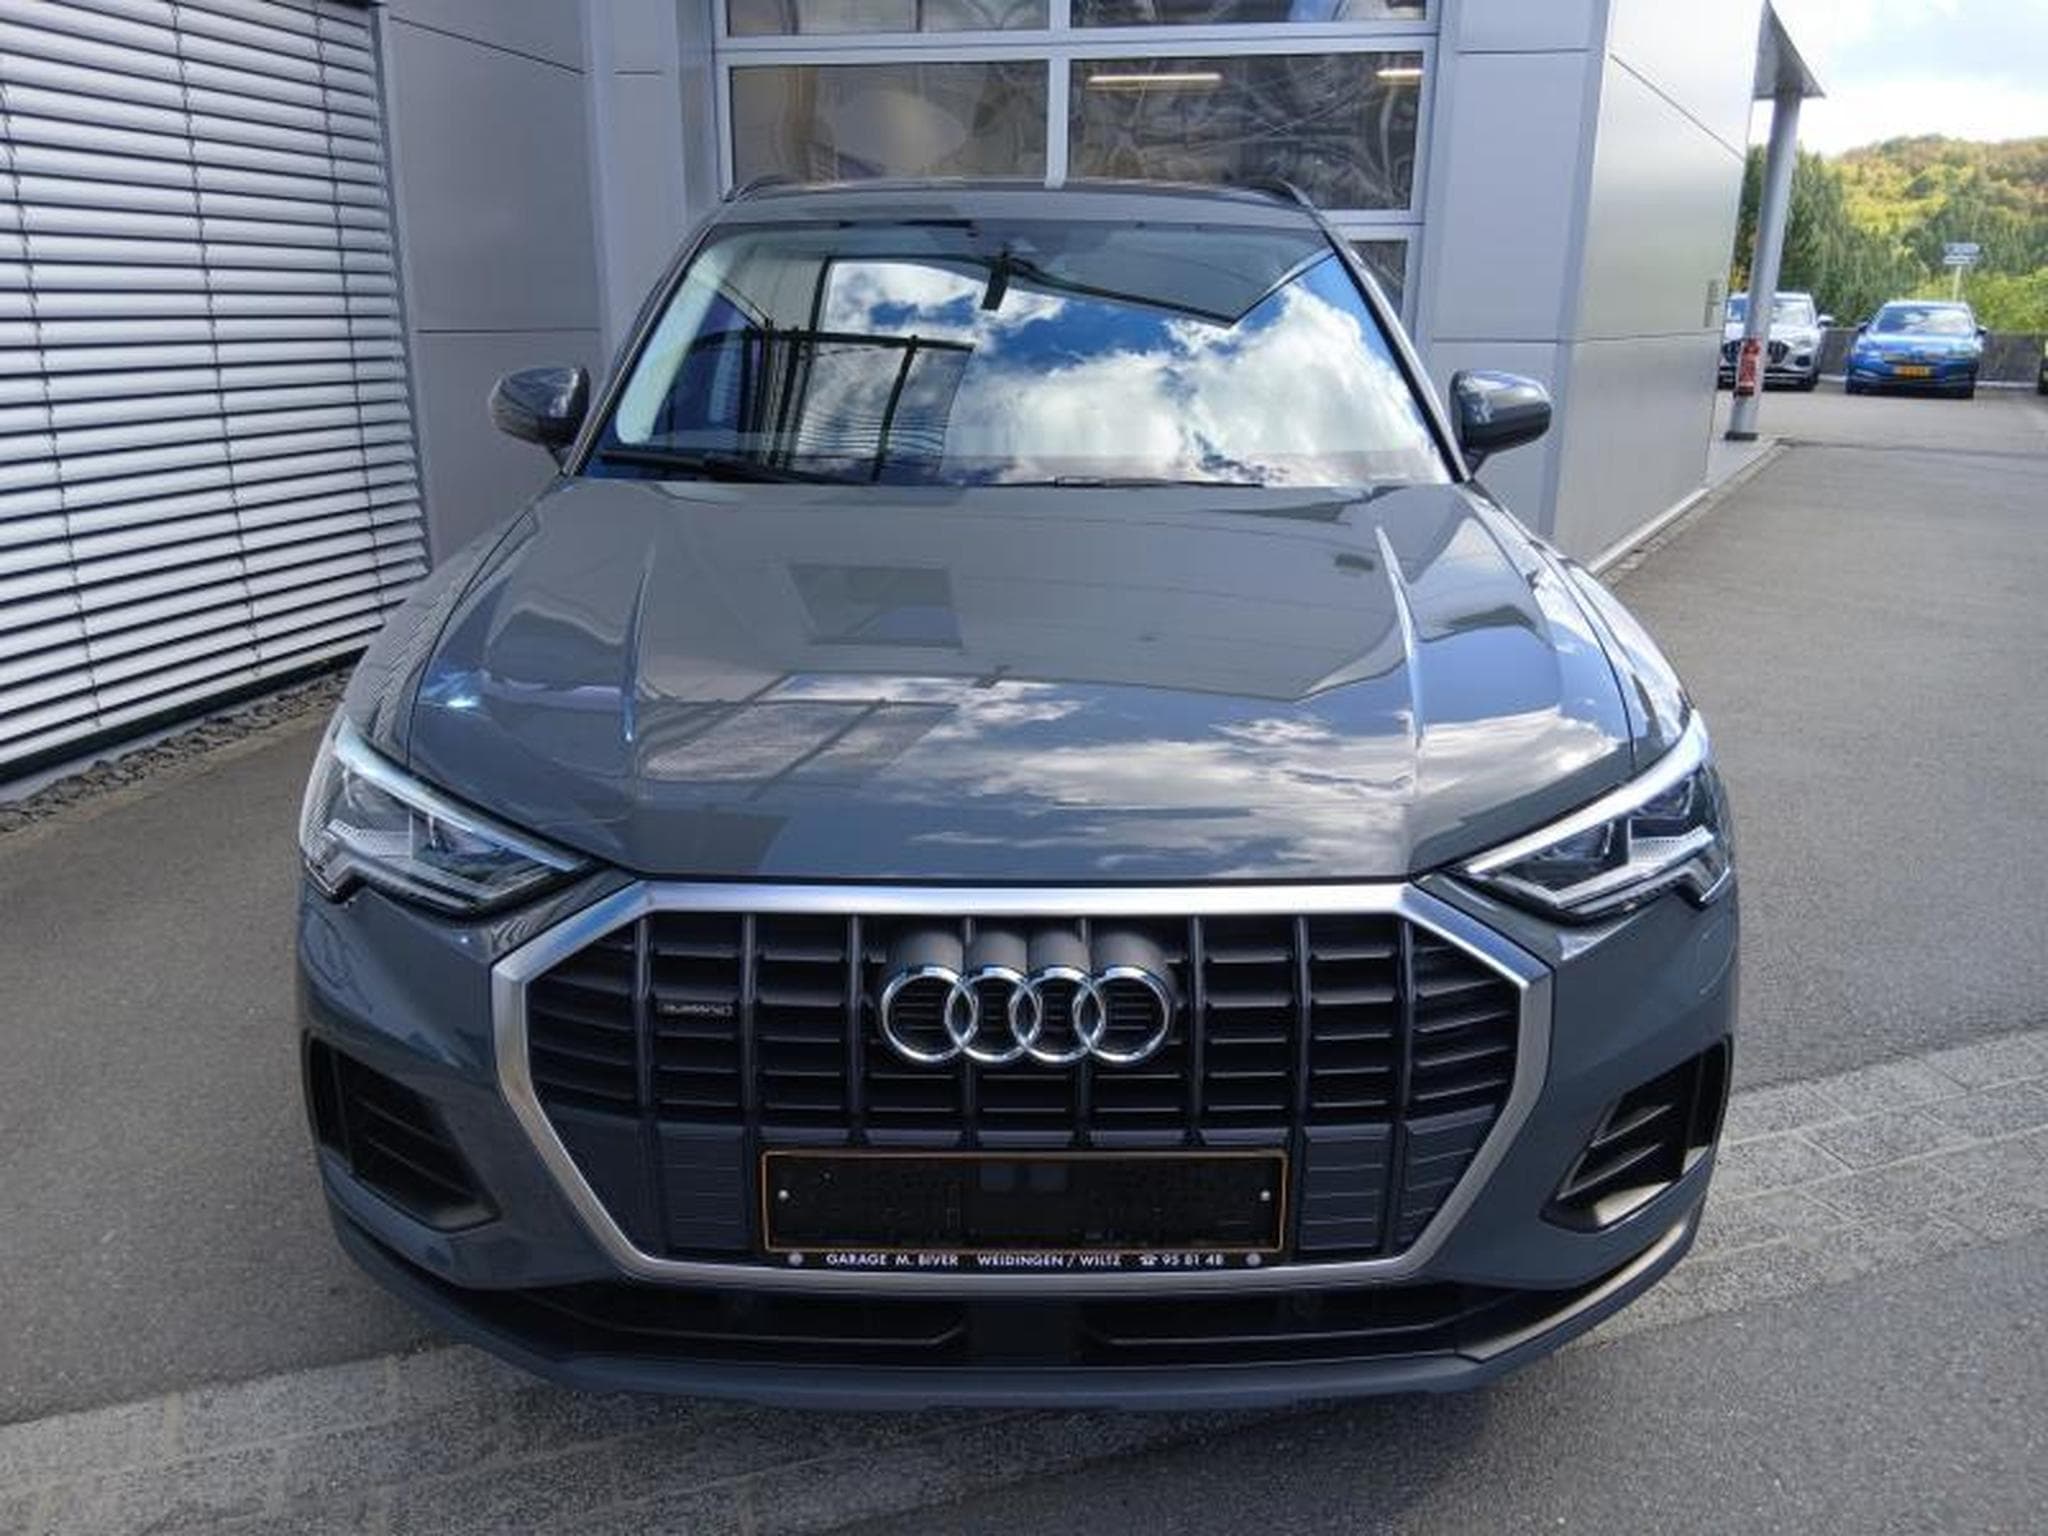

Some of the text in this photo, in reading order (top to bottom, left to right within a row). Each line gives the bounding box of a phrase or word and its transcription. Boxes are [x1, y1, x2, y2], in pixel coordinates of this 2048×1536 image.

[826, 1253, 887, 1266] GARAGE
[896, 1253, 914, 1266] M.
[918, 1253, 959, 1266] BIVER
[977, 1254, 1064, 1267] WEIDINGEN
[1080, 1253, 1121, 1267] WILTZ
